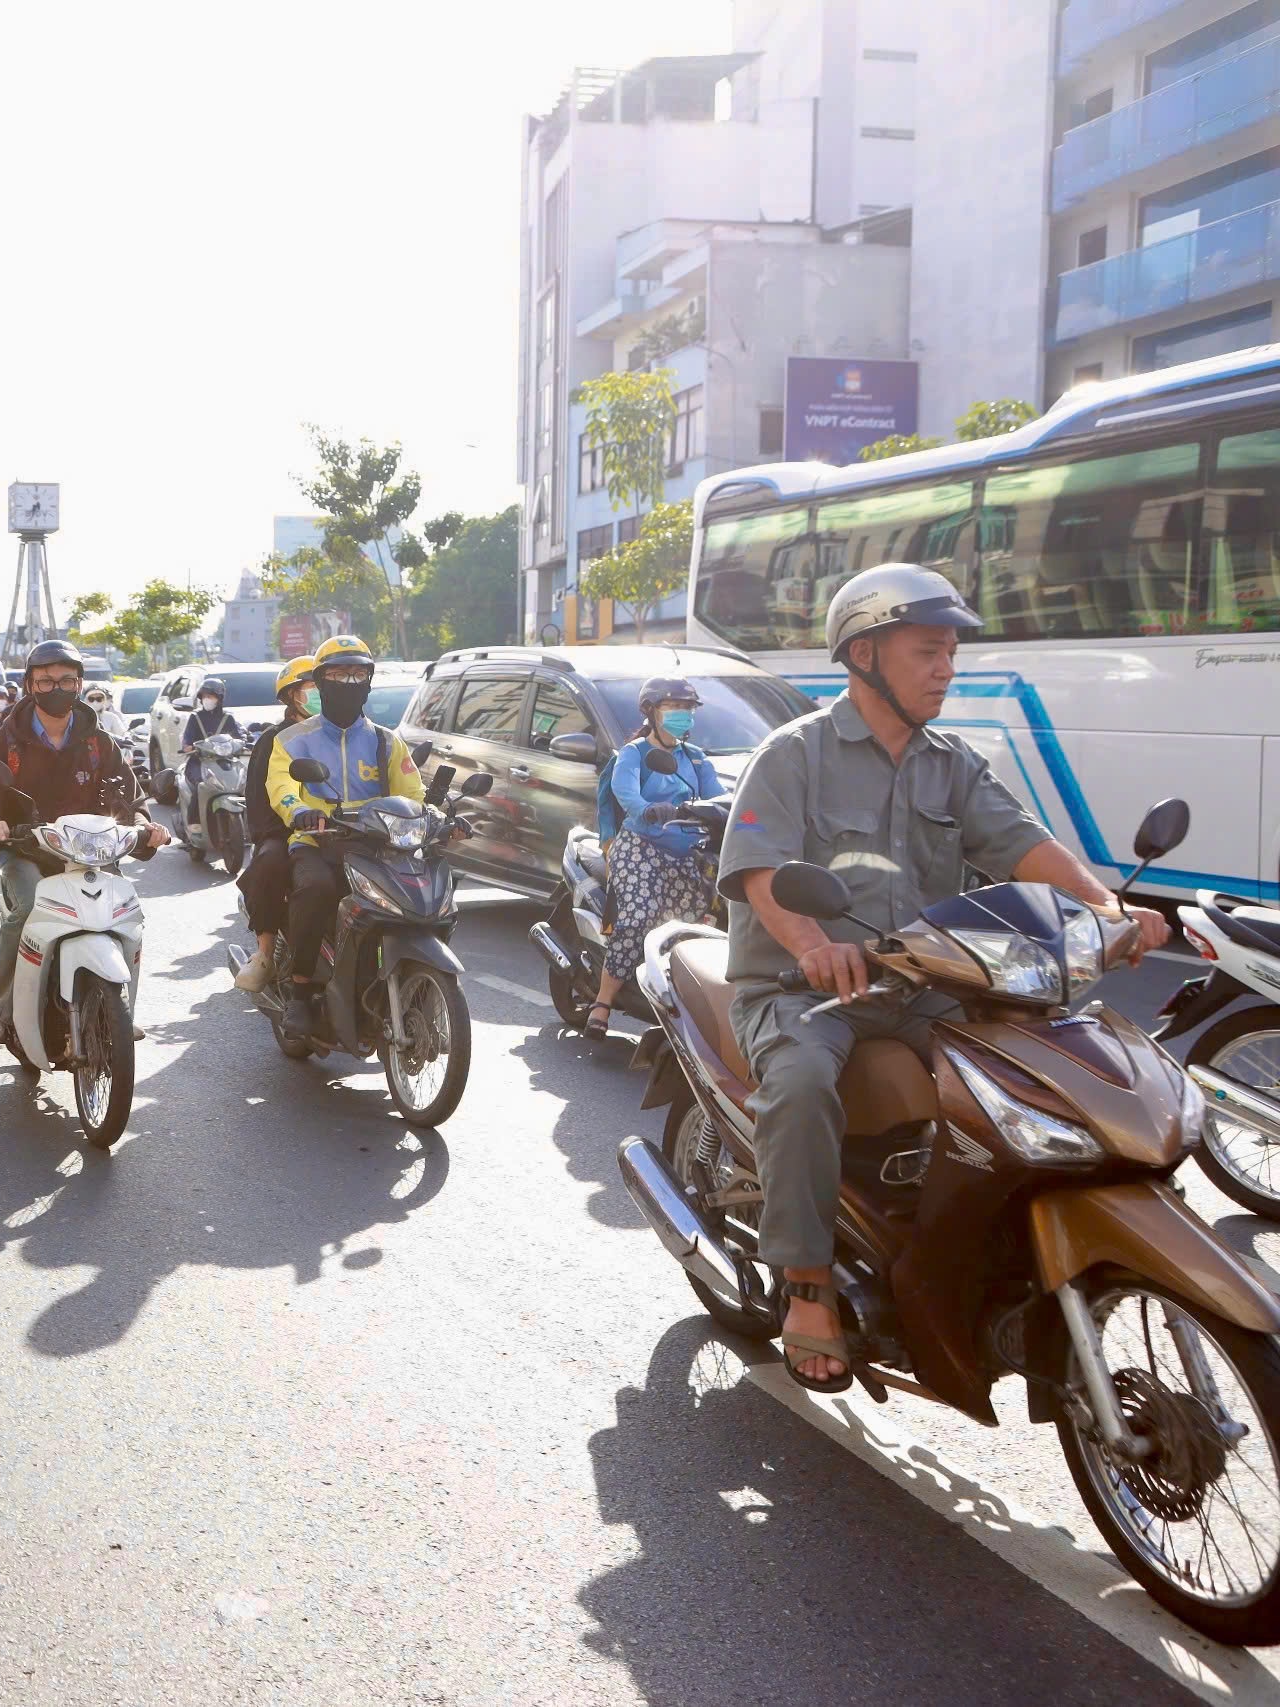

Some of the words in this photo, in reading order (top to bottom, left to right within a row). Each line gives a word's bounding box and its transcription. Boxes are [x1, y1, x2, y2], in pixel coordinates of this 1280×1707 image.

[805, 415, 838, 428] VNPT
[840, 416, 896, 430] eContract
[24, 935, 40, 951] YAMAHA
[945, 1150, 995, 1173] HONDA
